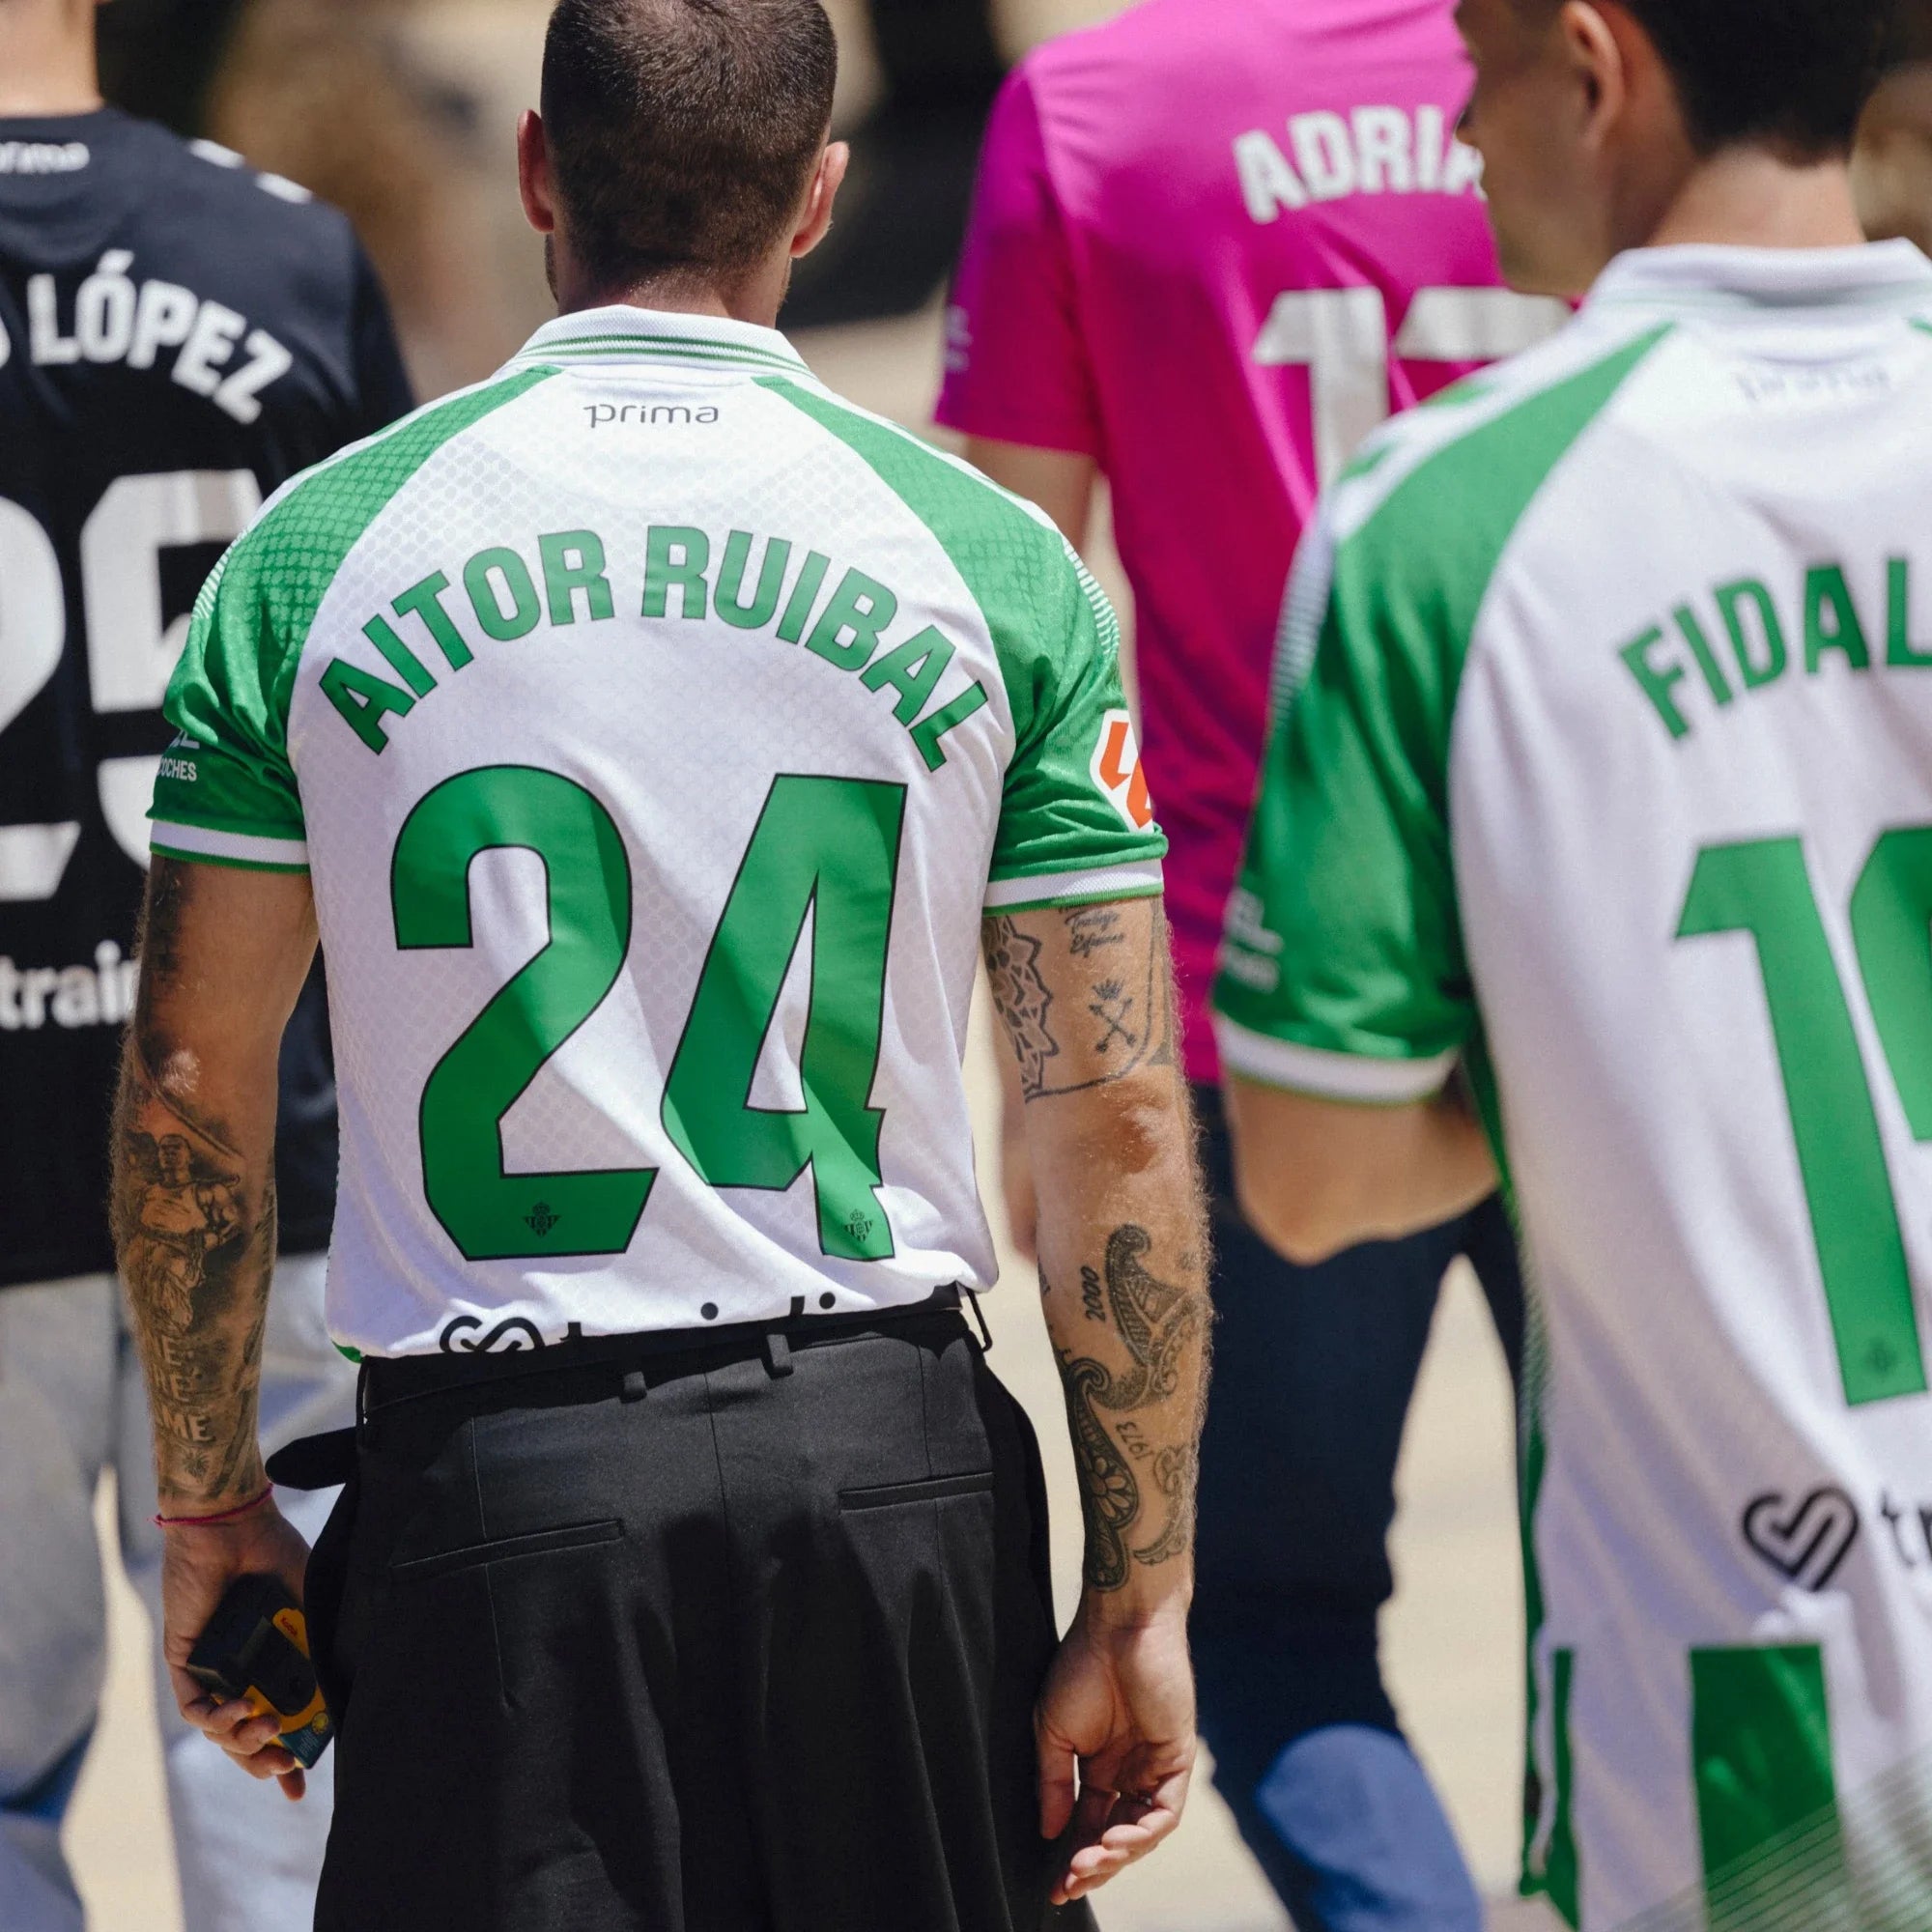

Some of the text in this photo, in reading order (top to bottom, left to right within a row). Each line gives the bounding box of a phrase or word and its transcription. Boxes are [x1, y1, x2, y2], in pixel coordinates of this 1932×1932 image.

[27, 248, 294, 425] LÓPEZ
[582, 404, 719, 428] prima
[319, 525, 988, 772] AITOR RUIBAL
[1619, 556, 1932, 739] FIDAL
[390, 764, 908, 1262] 24
[1081, 1264, 1106, 1322] 2000
